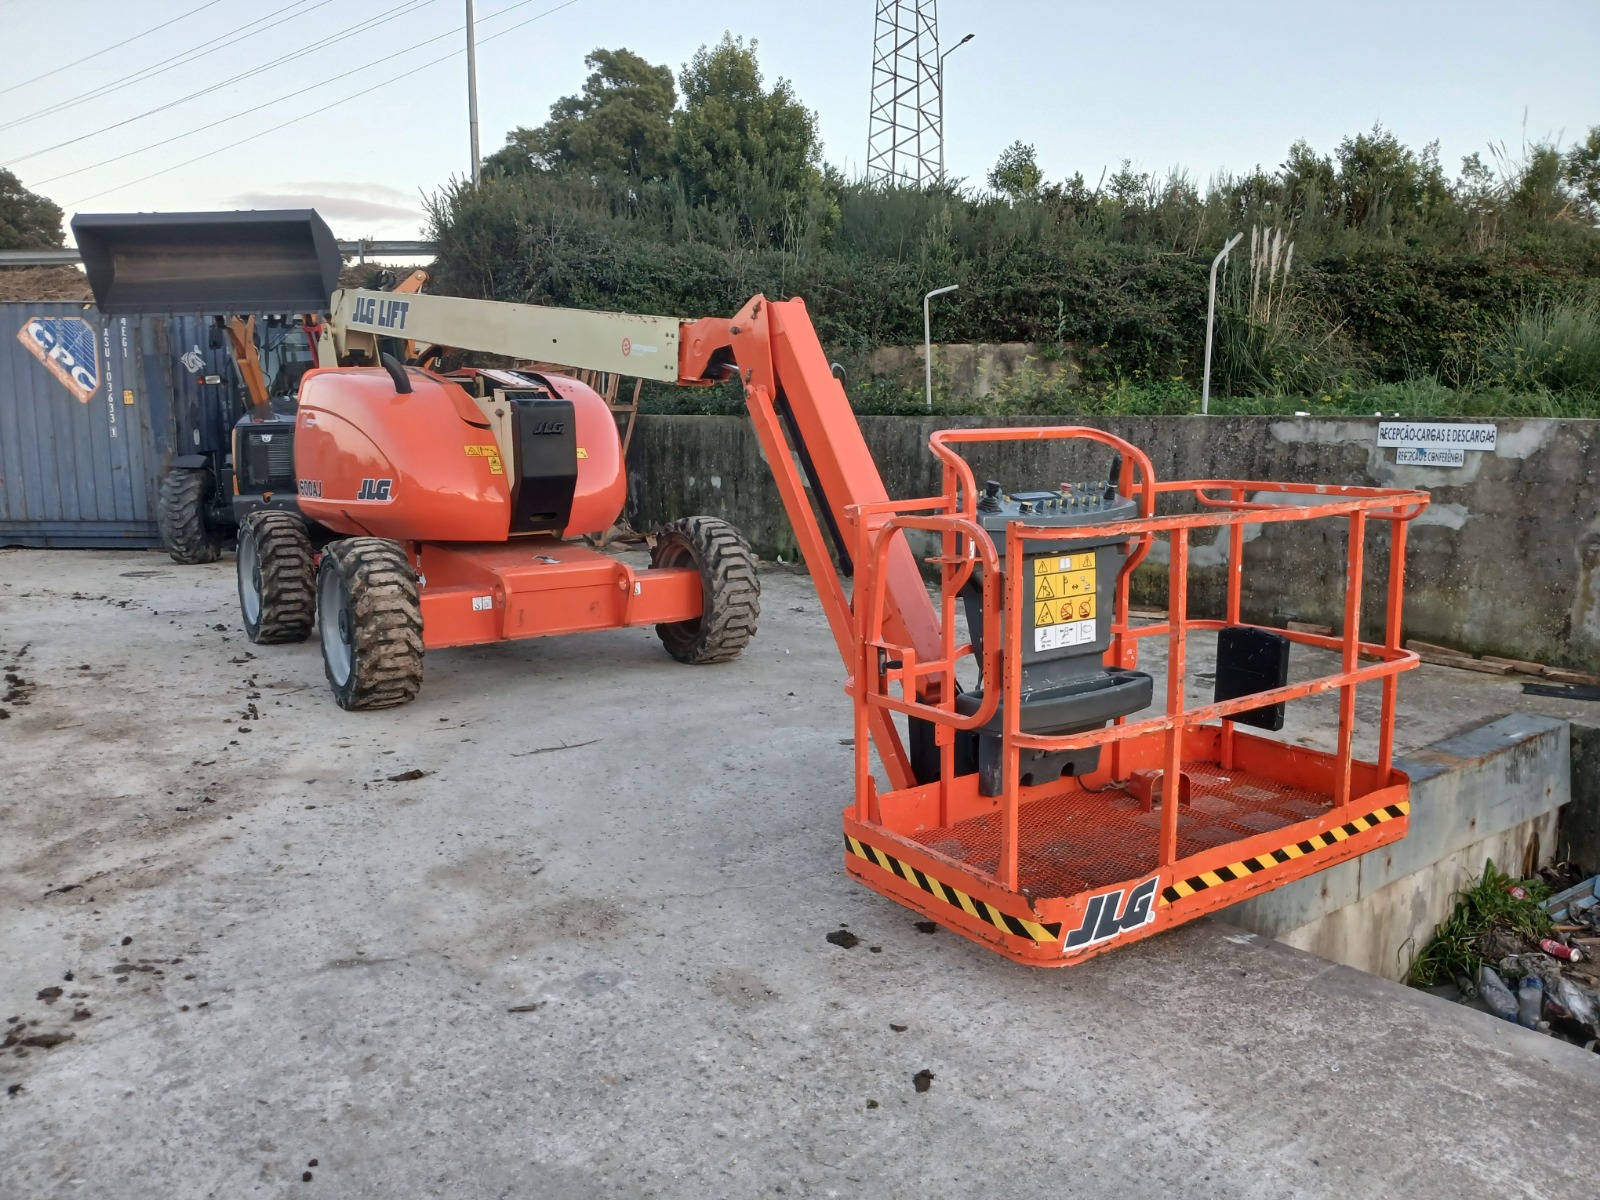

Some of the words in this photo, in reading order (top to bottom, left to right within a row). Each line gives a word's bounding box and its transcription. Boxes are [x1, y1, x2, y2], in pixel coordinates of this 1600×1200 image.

[352, 297, 376, 325] JLG
[378, 299, 410, 330] LIFT
[27, 322, 97, 392] CPC
[106, 361, 115, 424] 103633
[532, 422, 564, 436] JLG
[1446, 429, 1451, 442] E
[1452, 429, 1496, 443] DESCARGAS
[299, 480, 322, 498] 600AJ
[357, 479, 393, 501] JLG
[1064, 876, 1159, 951] JLG
